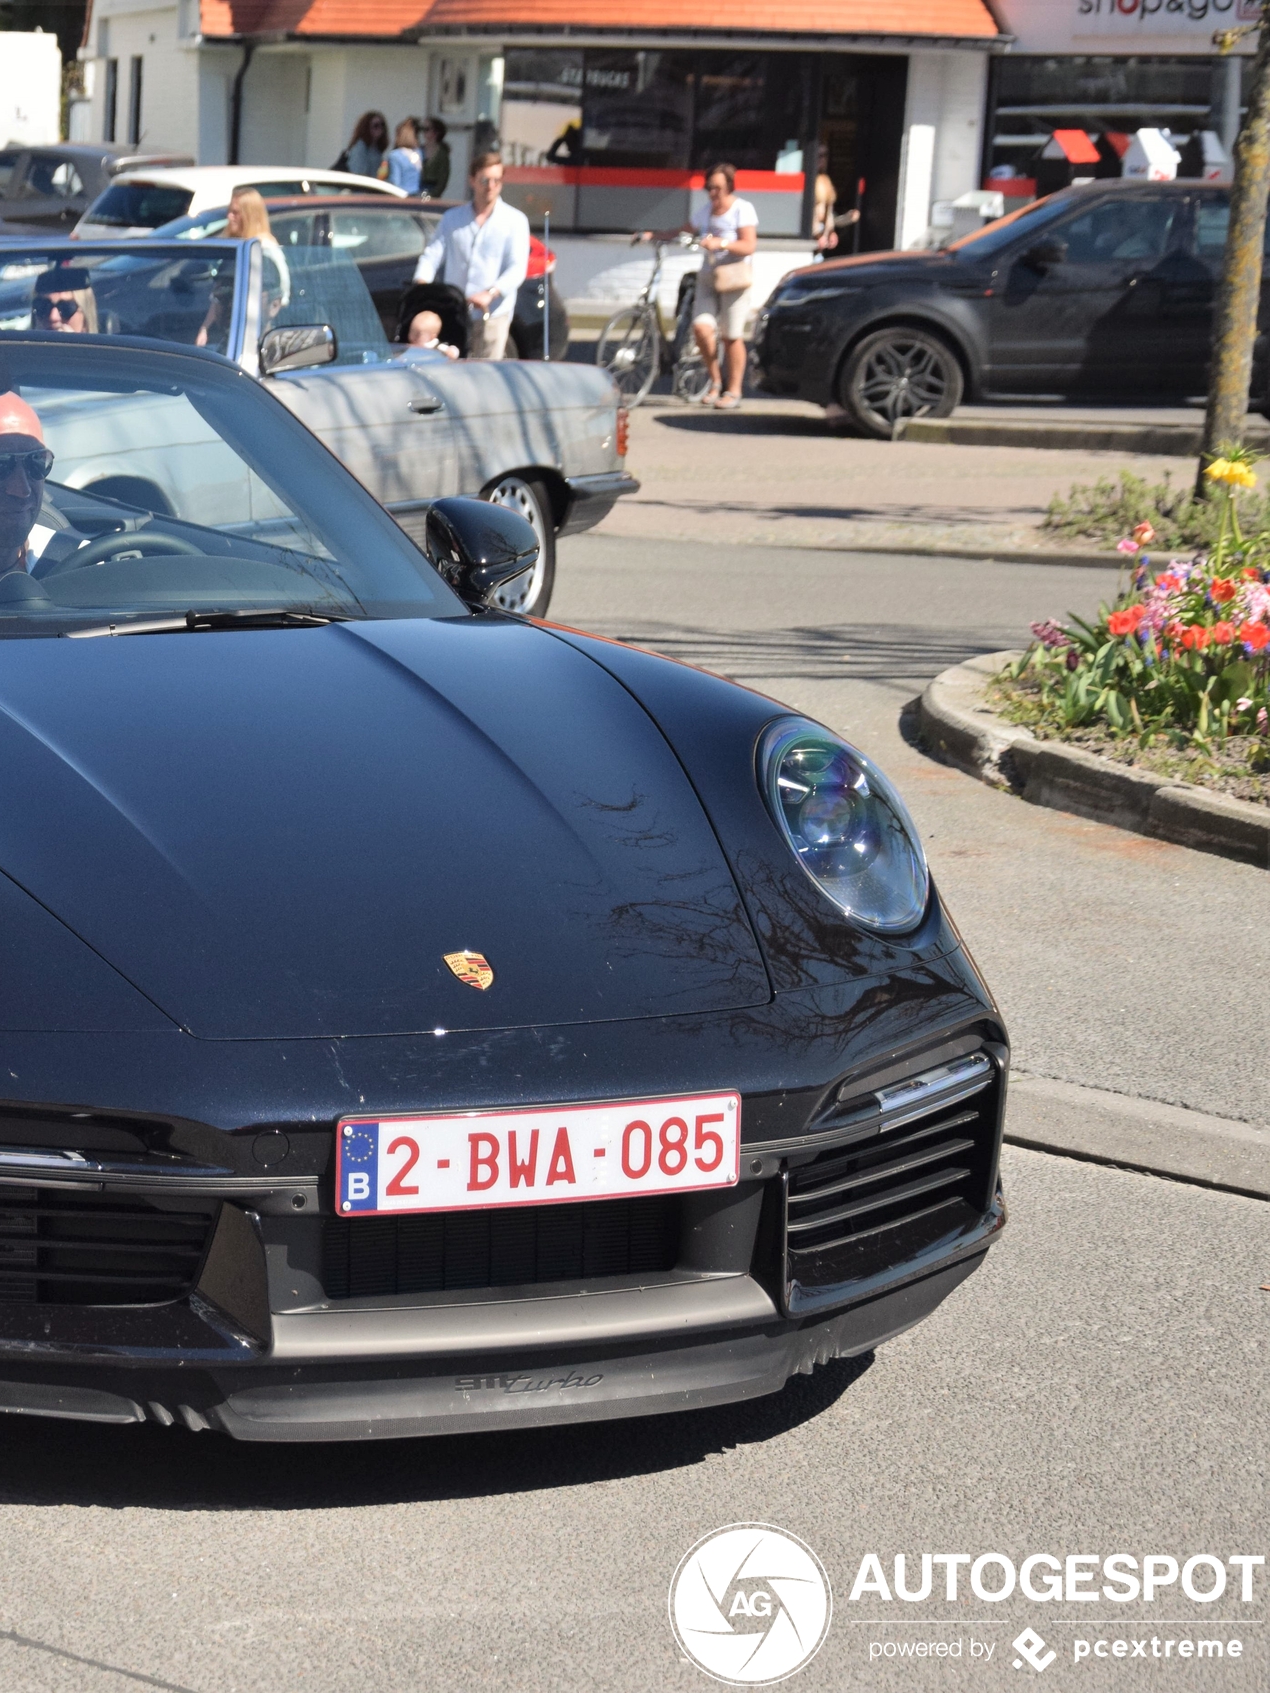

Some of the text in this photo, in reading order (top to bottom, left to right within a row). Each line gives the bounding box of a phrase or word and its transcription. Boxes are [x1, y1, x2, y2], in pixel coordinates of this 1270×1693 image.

[347, 1172, 370, 1200] B
[455, 1370, 604, 1395] 911 turbo
